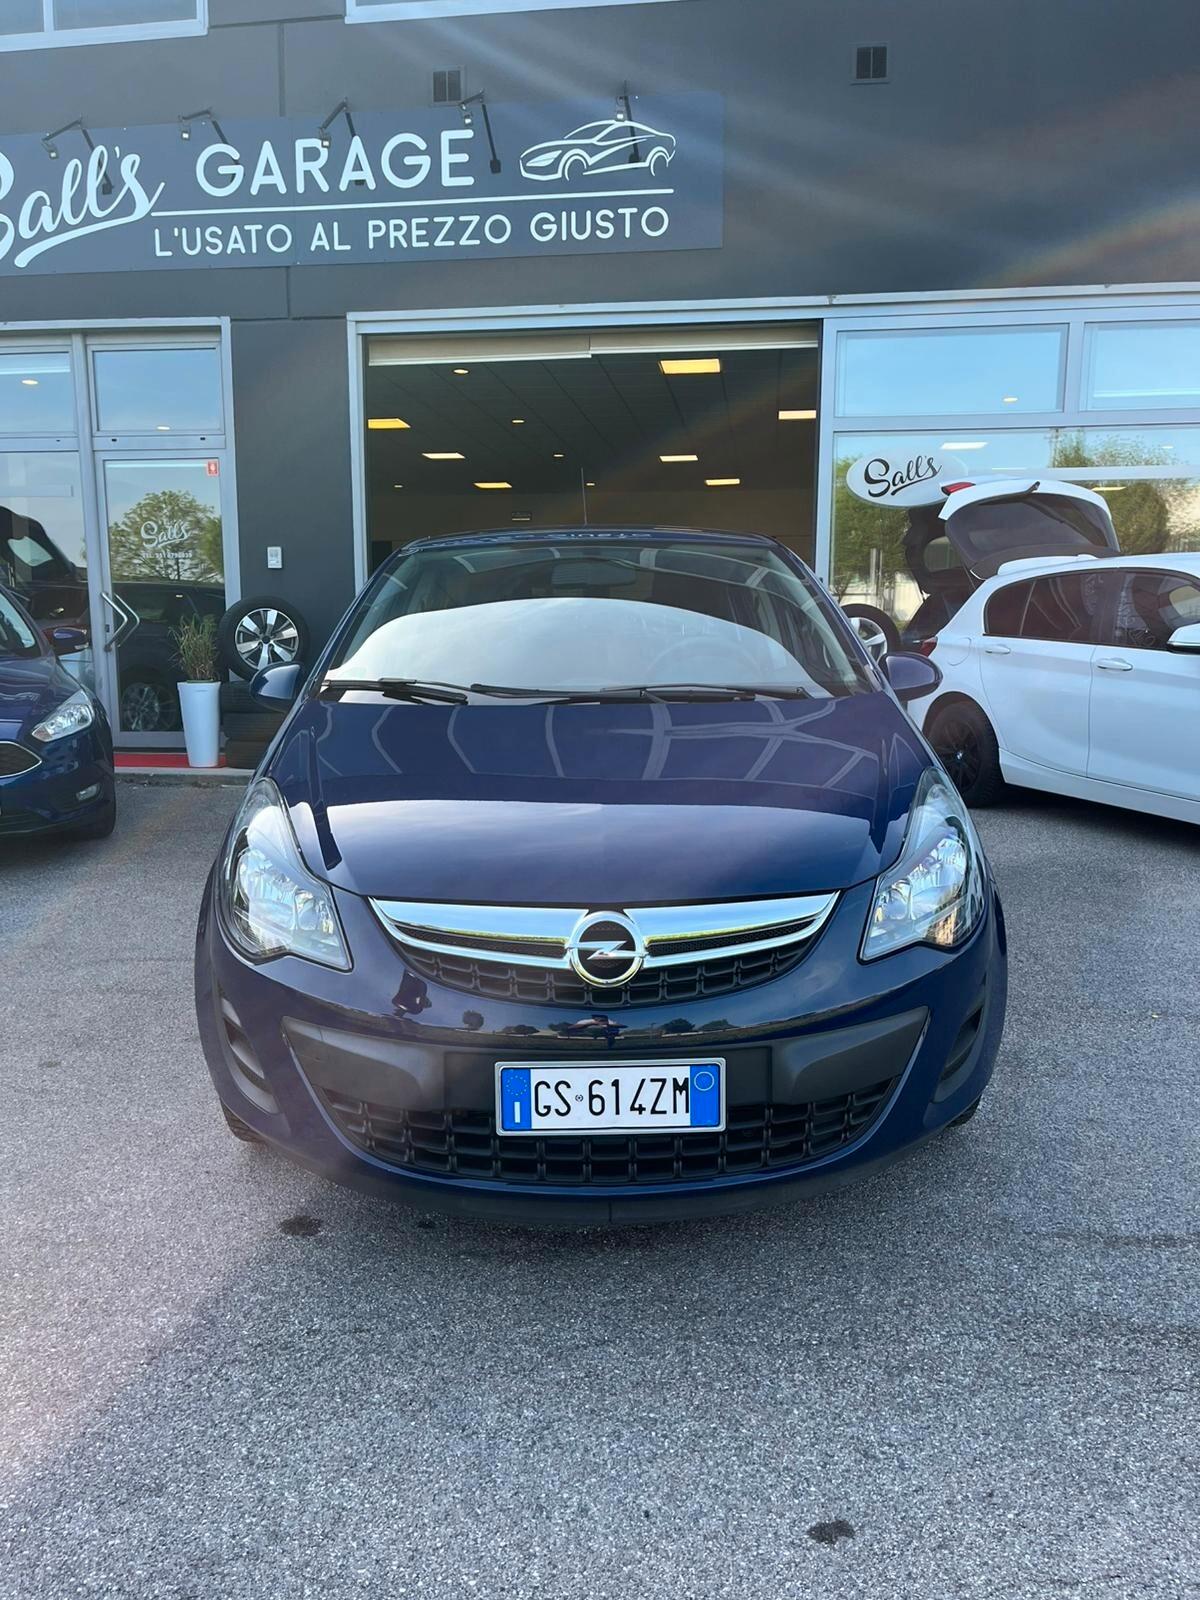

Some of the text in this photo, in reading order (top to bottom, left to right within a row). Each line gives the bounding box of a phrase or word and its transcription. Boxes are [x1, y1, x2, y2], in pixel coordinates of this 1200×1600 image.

[0, 128, 475, 268] all's GARAGE
[154, 206, 670, 257] L'USATO AL PREZZO GIUSTO
[863, 455, 943, 498] Sall's
